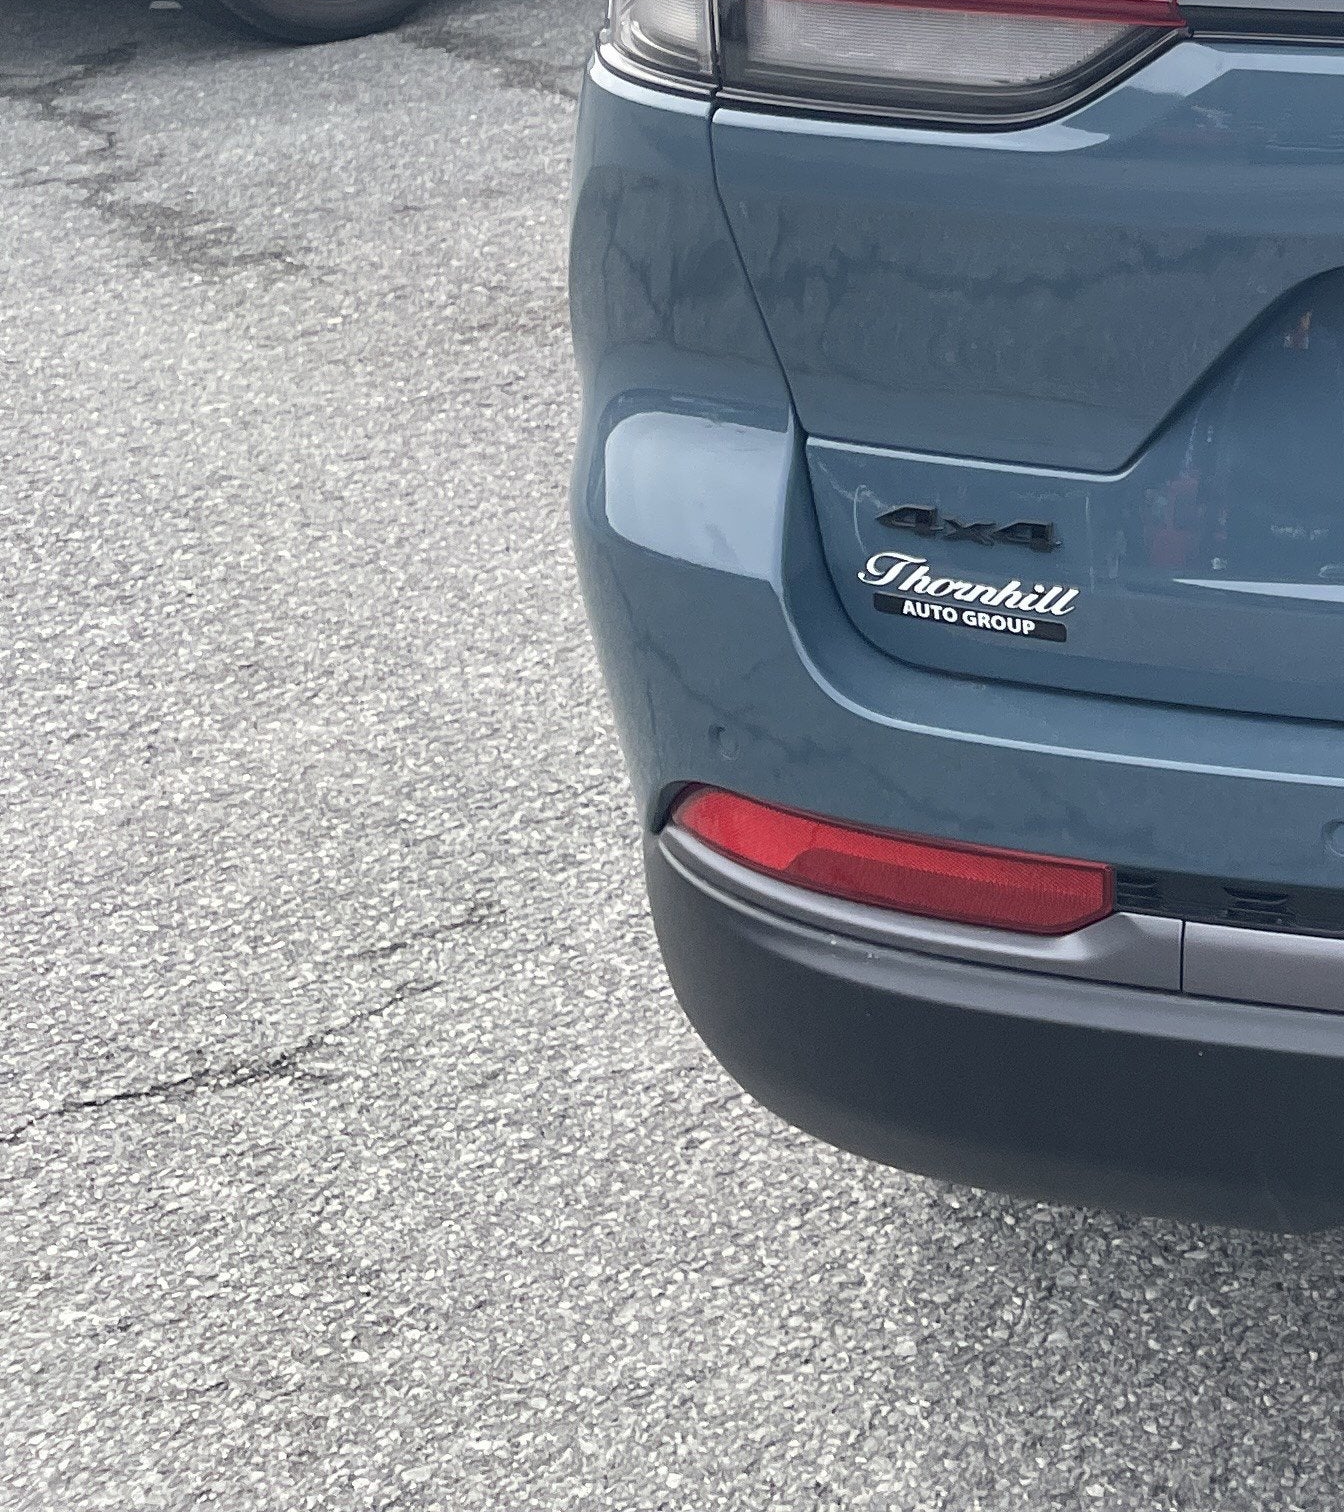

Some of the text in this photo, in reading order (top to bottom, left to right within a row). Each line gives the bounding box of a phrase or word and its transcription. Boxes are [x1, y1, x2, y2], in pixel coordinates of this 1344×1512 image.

[856, 550, 1081, 617] Thornhill
[902, 599, 1036, 636] AUTO GROUP
